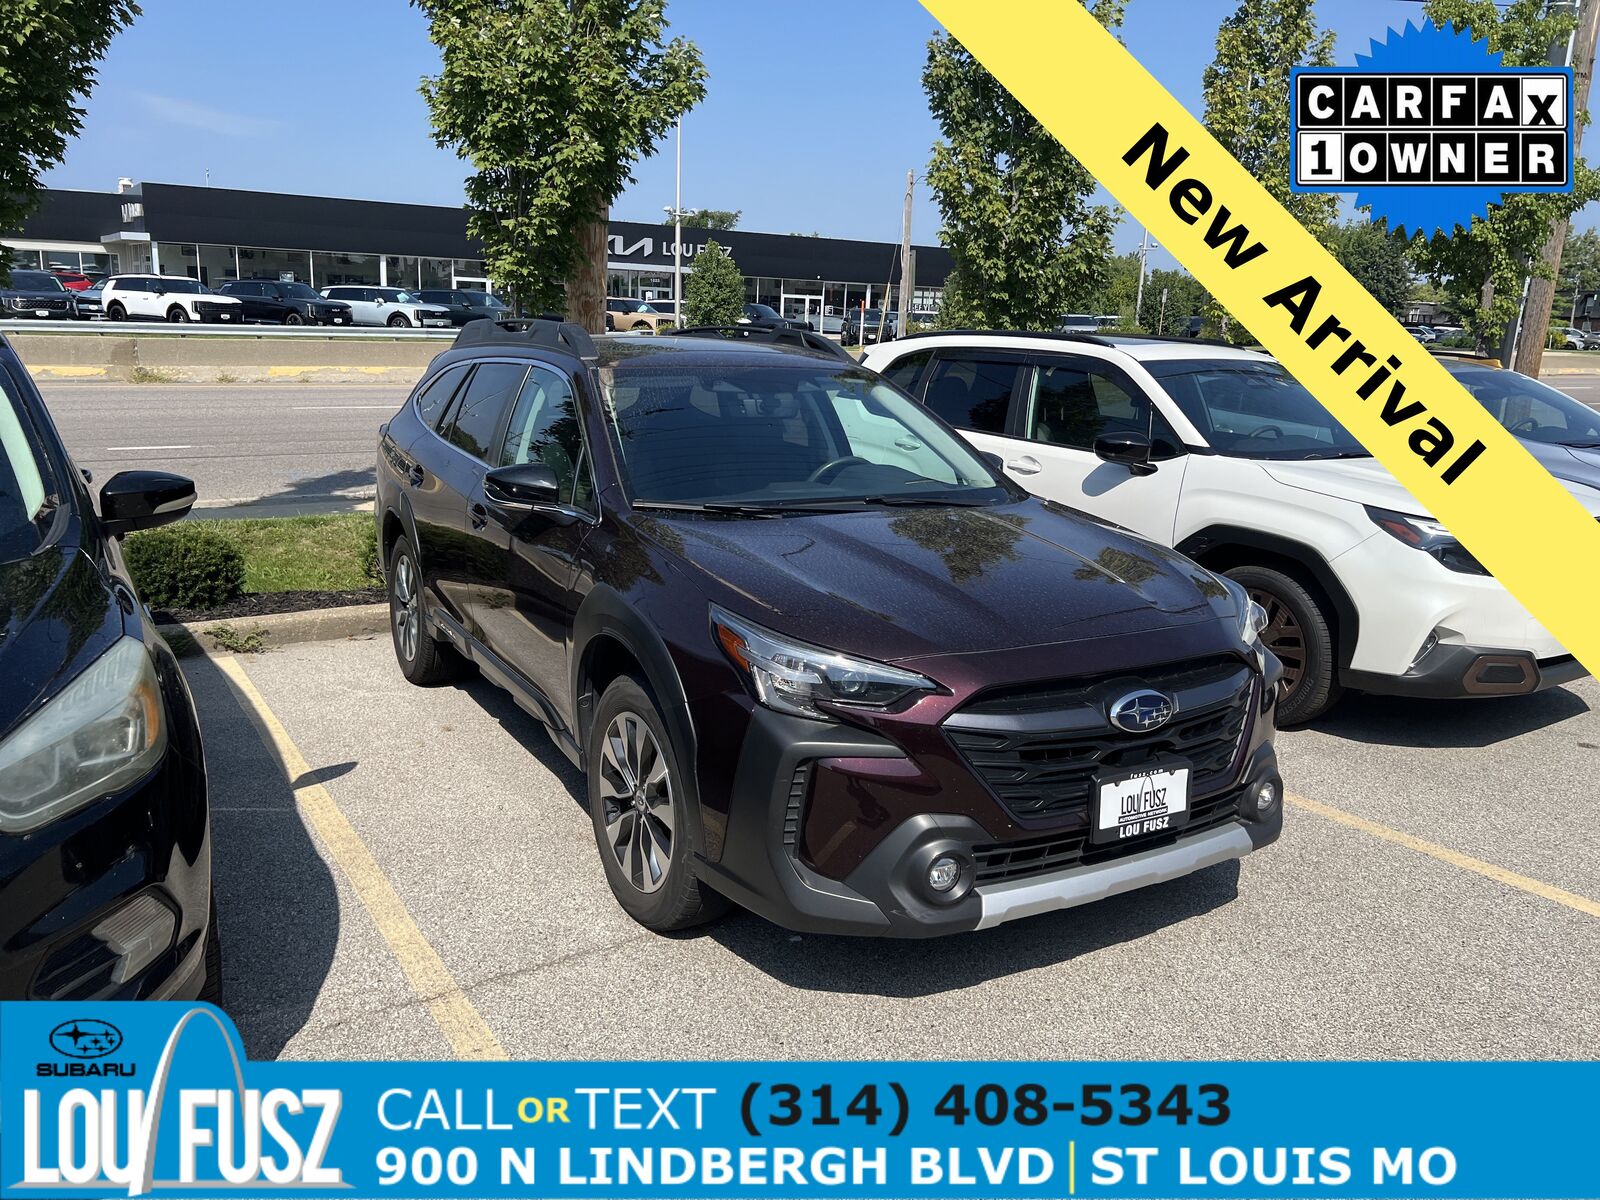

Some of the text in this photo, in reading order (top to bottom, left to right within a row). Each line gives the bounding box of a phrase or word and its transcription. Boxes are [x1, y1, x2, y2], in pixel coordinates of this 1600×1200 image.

[662, 241, 693, 258] LOU
[1130, 768, 1164, 780] fusz.com
[1121, 787, 1167, 816] LOU FUSZ
[1119, 815, 1170, 839] LOU FUSZ
